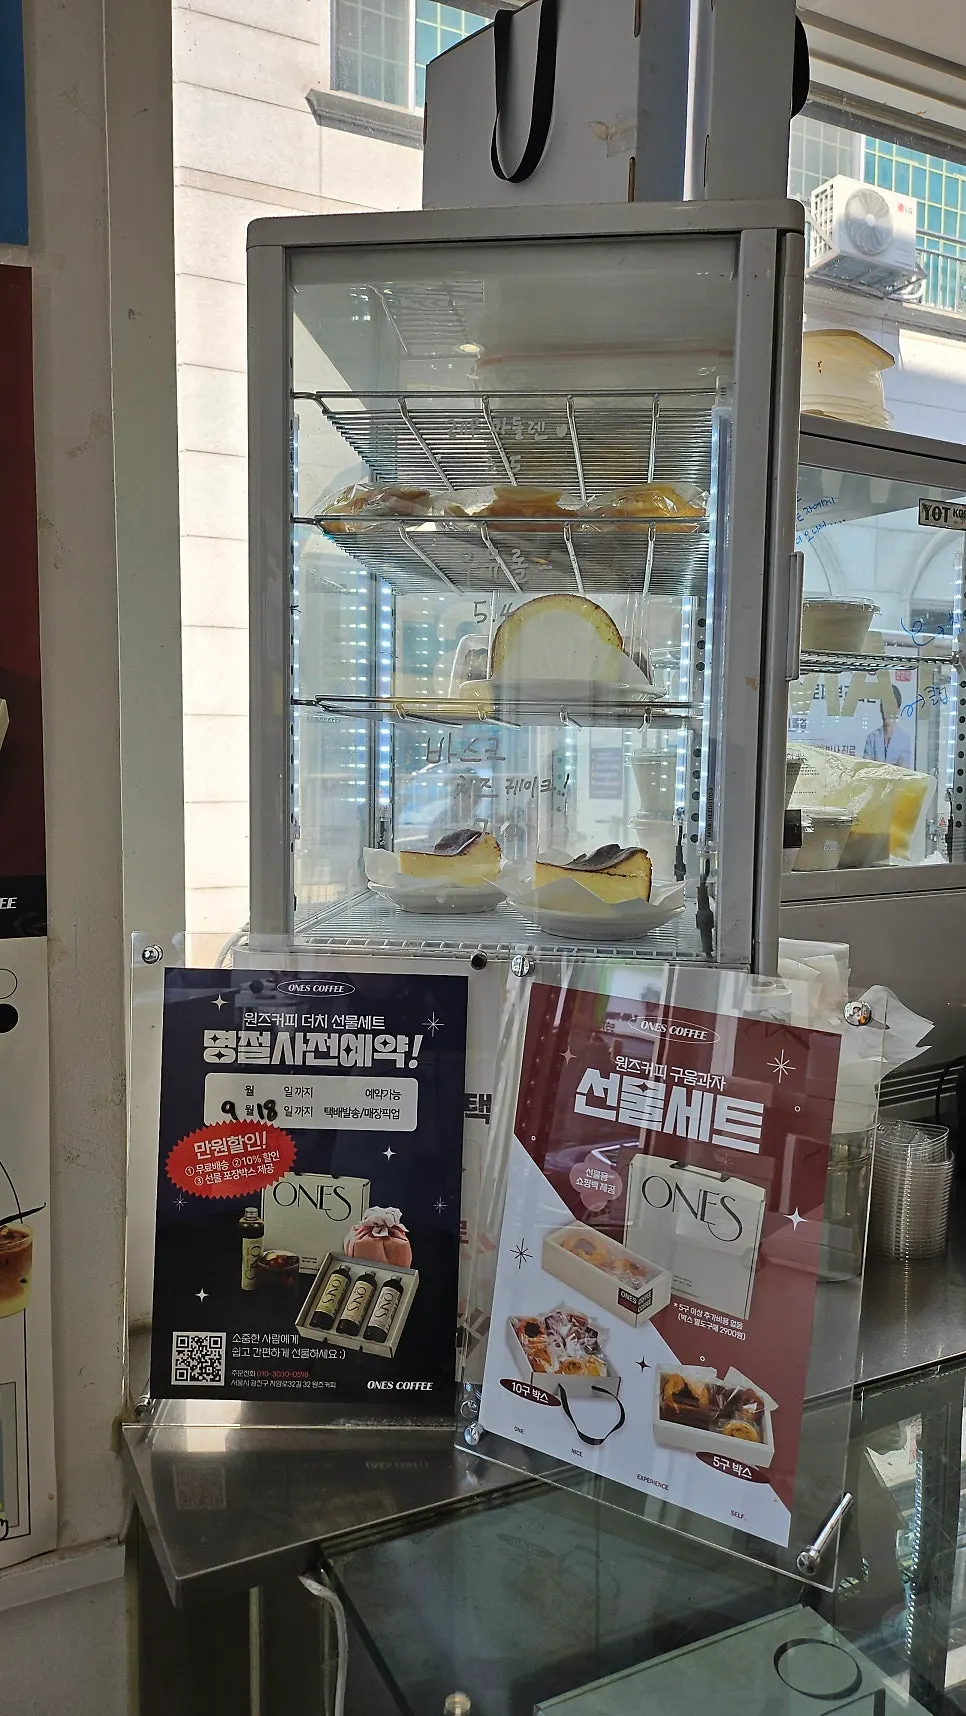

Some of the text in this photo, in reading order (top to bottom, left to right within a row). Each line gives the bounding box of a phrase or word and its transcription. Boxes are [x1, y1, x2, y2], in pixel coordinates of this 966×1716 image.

[426, 732, 506, 763] 바스크
[288, 984, 345, 993] ONES COFFEE
[244, 1012, 386, 1031] 원즈커피 더치 선물세트
[640, 1020, 667, 1033] ONES
[669, 1025, 708, 1041] COFFEE
[203, 1029, 424, 1069] 명절사전예약!
[615, 1055, 727, 1092] 원즈커피 구움과자
[245, 1085, 254, 1096] 월
[365, 1088, 402, 1100] 예약가능
[221, 1100, 239, 1120] 9
[257, 1099, 278, 1121] 18
[324, 1106, 400, 1120] 택배발송/매장픽업
[573, 1067, 765, 1154] 선물세트
[193, 1131, 267, 1160] 만원할인!
[262, 1150, 280, 1163] 할인
[257, 1163, 275, 1175] 제공
[273, 1181, 352, 1222] ONES
[641, 1175, 743, 1242] ONES
[231, 1333, 299, 1345] 소중한 사람에게
[231, 1347, 250, 1358] 쉽고
[252, 1347, 290, 1358] 간편하게
[367, 1380, 434, 1391] ONES COFFEE
[511, 1382, 549, 1404] 10구 박스
[514, 1426, 525, 1434] ONE
[571, 1448, 583, 1457] NICE
[712, 1456, 753, 1479] 5구 박스
[636, 1474, 669, 1491] EXPERIENCE
